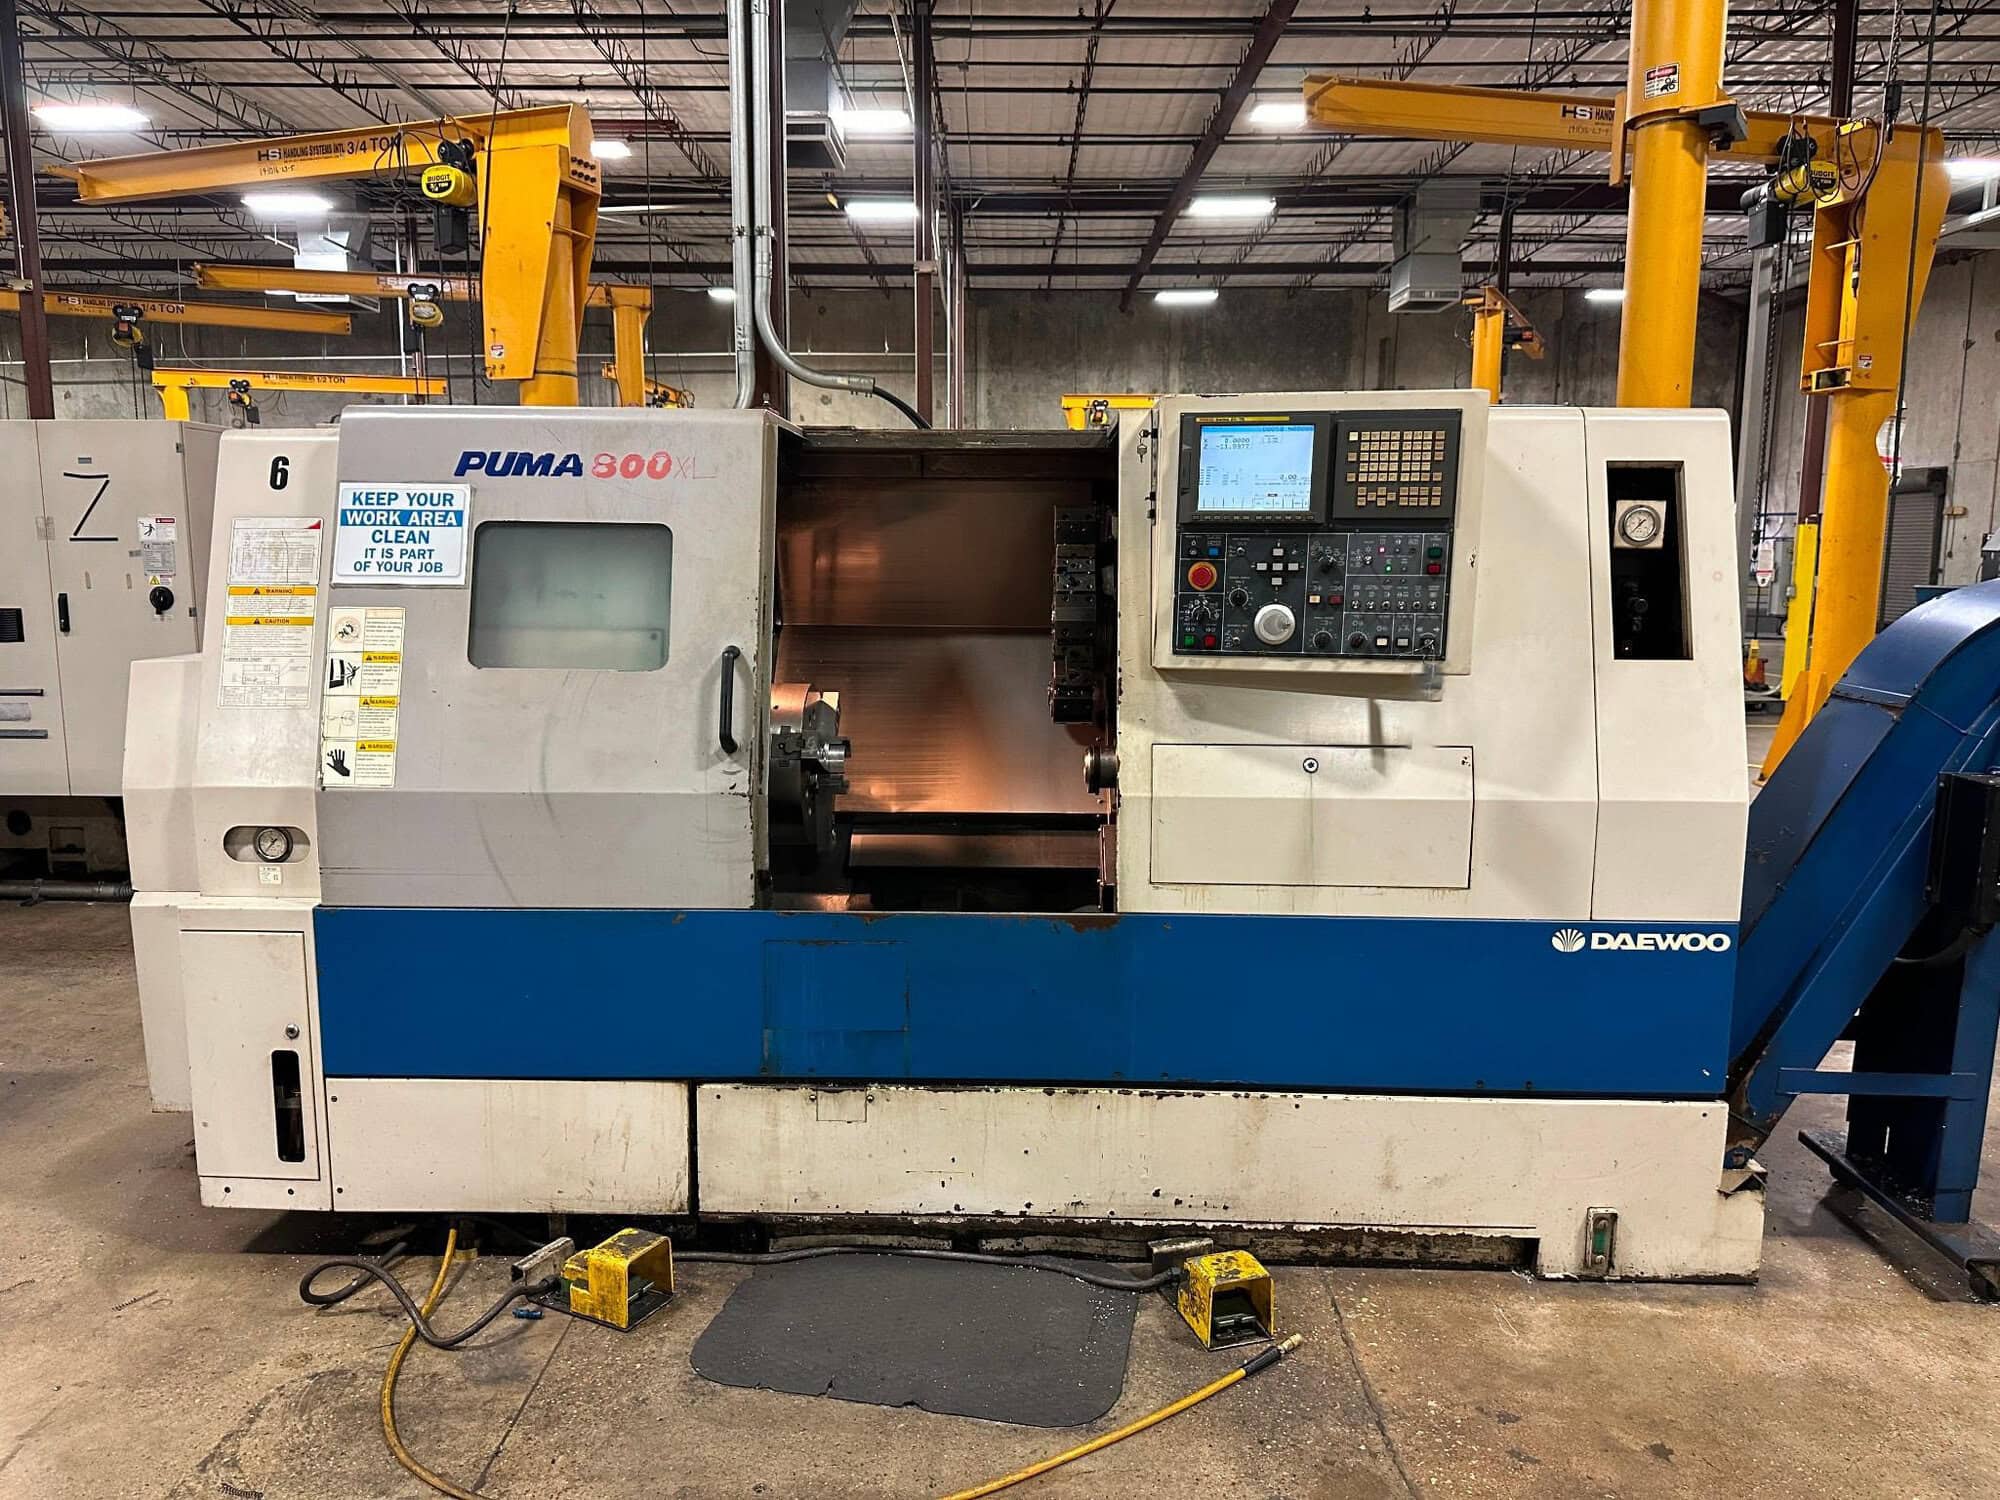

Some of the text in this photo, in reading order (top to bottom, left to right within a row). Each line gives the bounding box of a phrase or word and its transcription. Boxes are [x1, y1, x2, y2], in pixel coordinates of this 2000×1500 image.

[284, 146, 308, 159] HANDLING
[309, 144, 332, 157] SYSTEMS
[347, 138, 368, 155] 3/4
[370, 135, 401, 151] TON
[143, 303, 157, 313] 1/4
[159, 303, 186, 315] TON
[330, 376, 346, 385] TON
[453, 451, 583, 477] PUMA
[270, 456, 289, 490] 6
[352, 491, 454, 506] KEEP YOUR
[346, 511, 457, 526] WORK AREA
[371, 529, 430, 544] CLEAN
[364, 548, 435, 559] IT IS PART
[353, 561, 443, 573] OF YOUR JOB
[1591, 932, 1731, 952] DAEWOO
